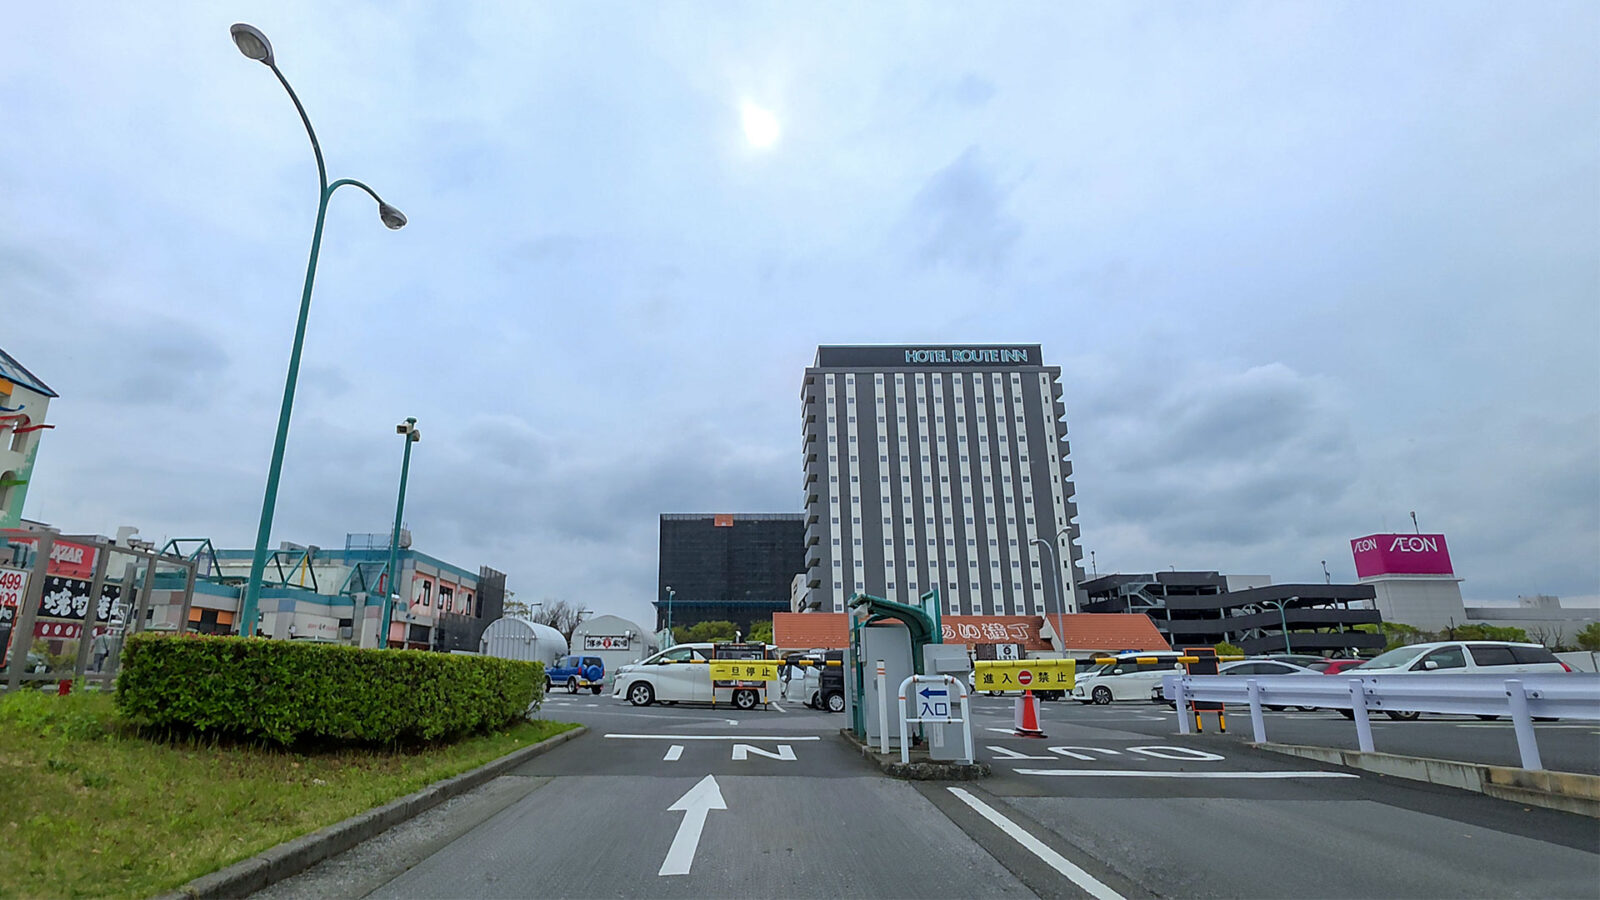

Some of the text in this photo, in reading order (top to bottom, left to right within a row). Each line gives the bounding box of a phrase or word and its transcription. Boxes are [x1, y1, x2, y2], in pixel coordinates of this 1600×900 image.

[905, 349, 1028, 363] HOTEL ROUTE INN
[716, 666, 770, 677] 一旦停止
[921, 702, 947, 716] 入口
[663, 744, 798, 761] IN
